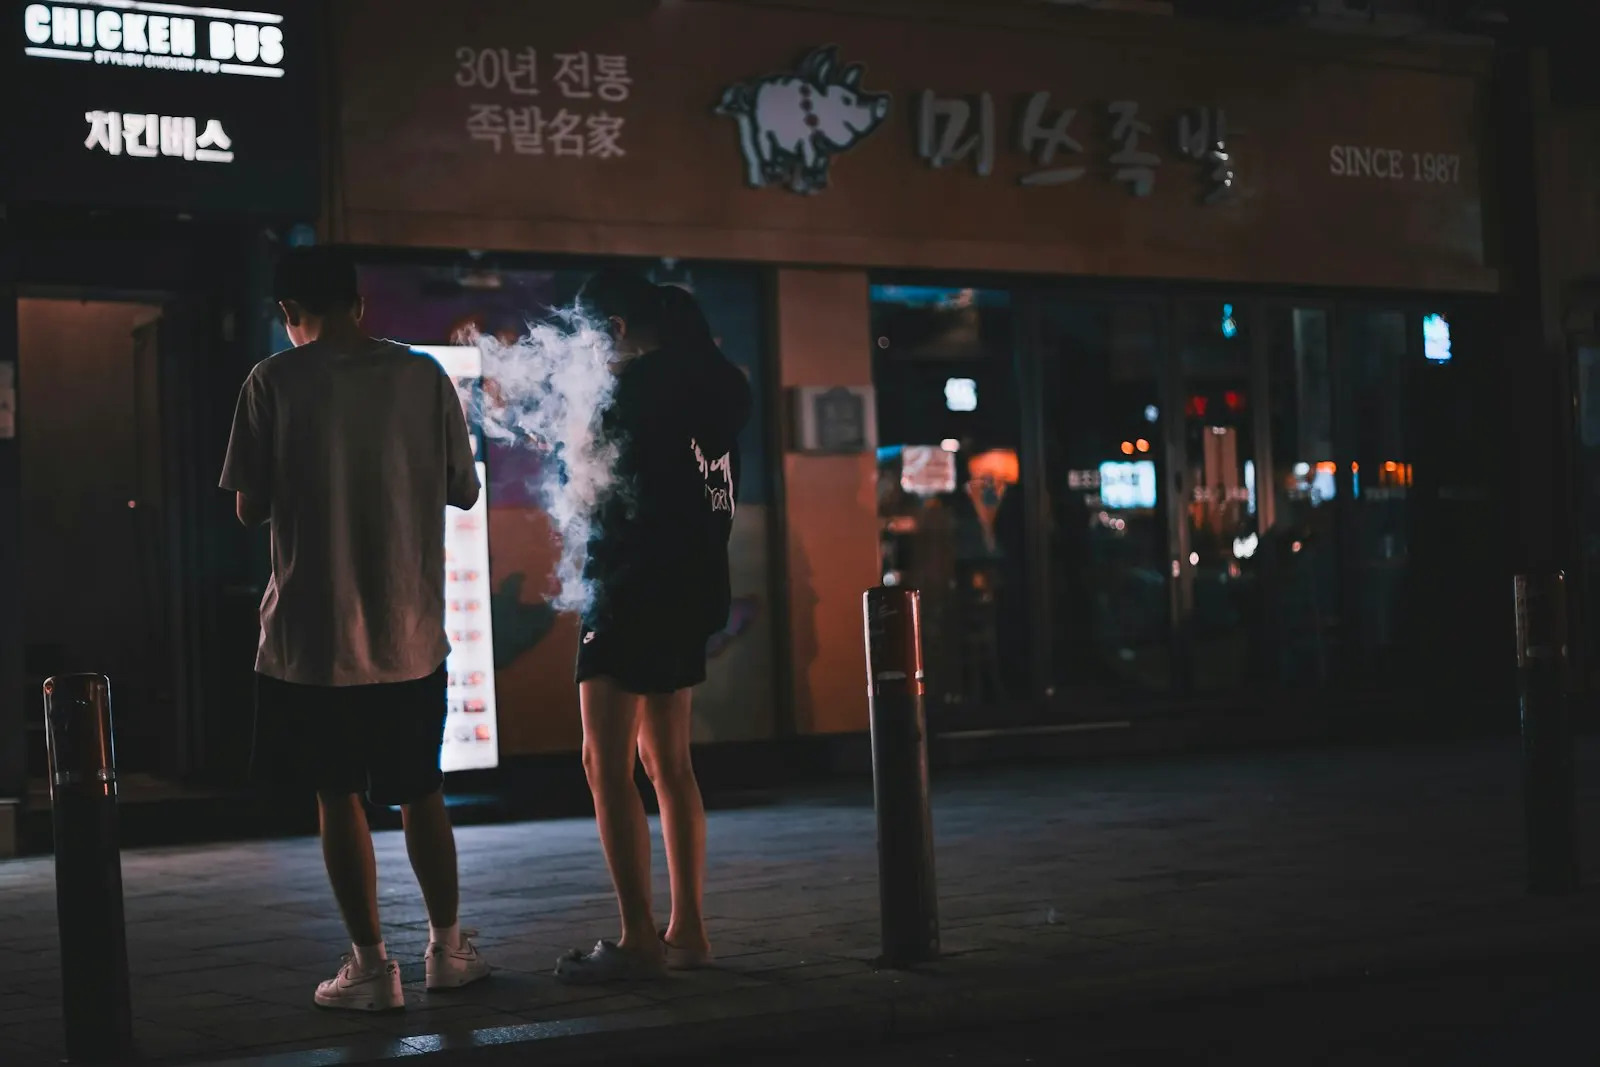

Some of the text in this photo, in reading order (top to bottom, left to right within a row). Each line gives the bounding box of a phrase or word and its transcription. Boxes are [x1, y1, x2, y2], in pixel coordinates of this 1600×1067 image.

[25, 4, 285, 65] CHICKEN BUS
[455, 46, 634, 102] 30년 전통
[84, 110, 235, 163] 치킨버스
[466, 104, 627, 159] 족발名家
[1329, 144, 1461, 184] SINCE 1987
